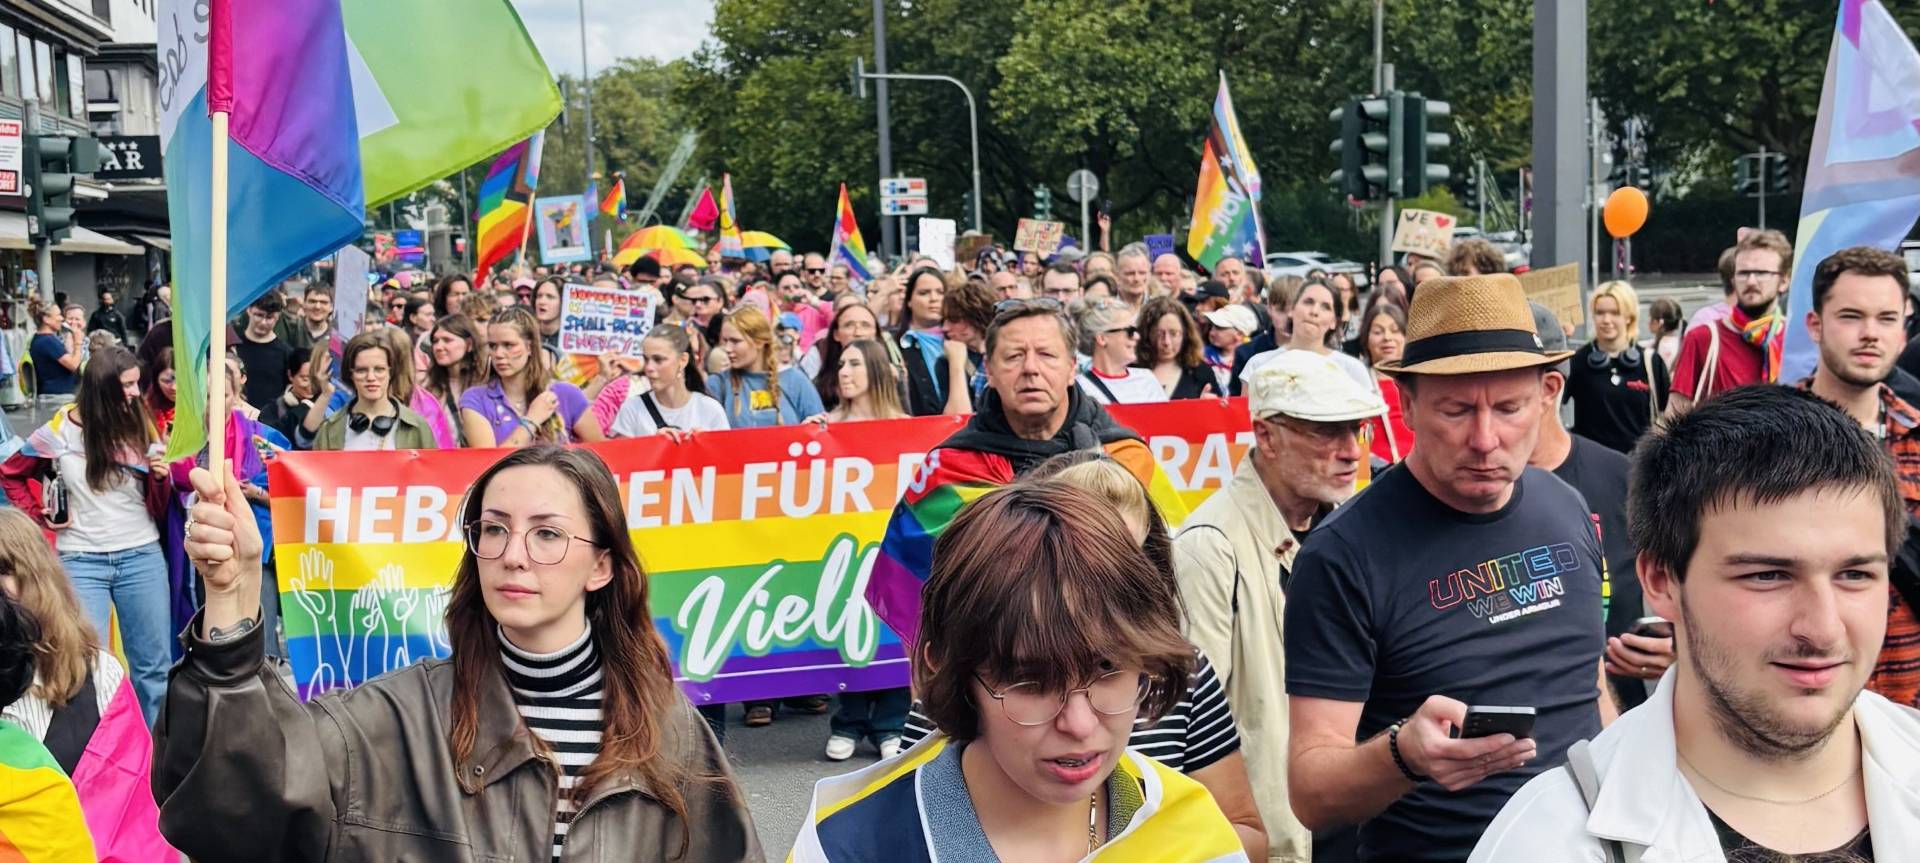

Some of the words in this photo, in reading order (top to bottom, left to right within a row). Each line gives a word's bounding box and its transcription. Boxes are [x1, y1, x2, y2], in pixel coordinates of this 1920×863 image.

[1405, 211, 1429, 225] WE
[741, 441, 875, 519] FÜR
[1429, 542, 1581, 610] UNITED
[1467, 592, 1511, 618] WE
[1509, 577, 1565, 604] WIN
[1488, 609, 1521, 624] UNDER
